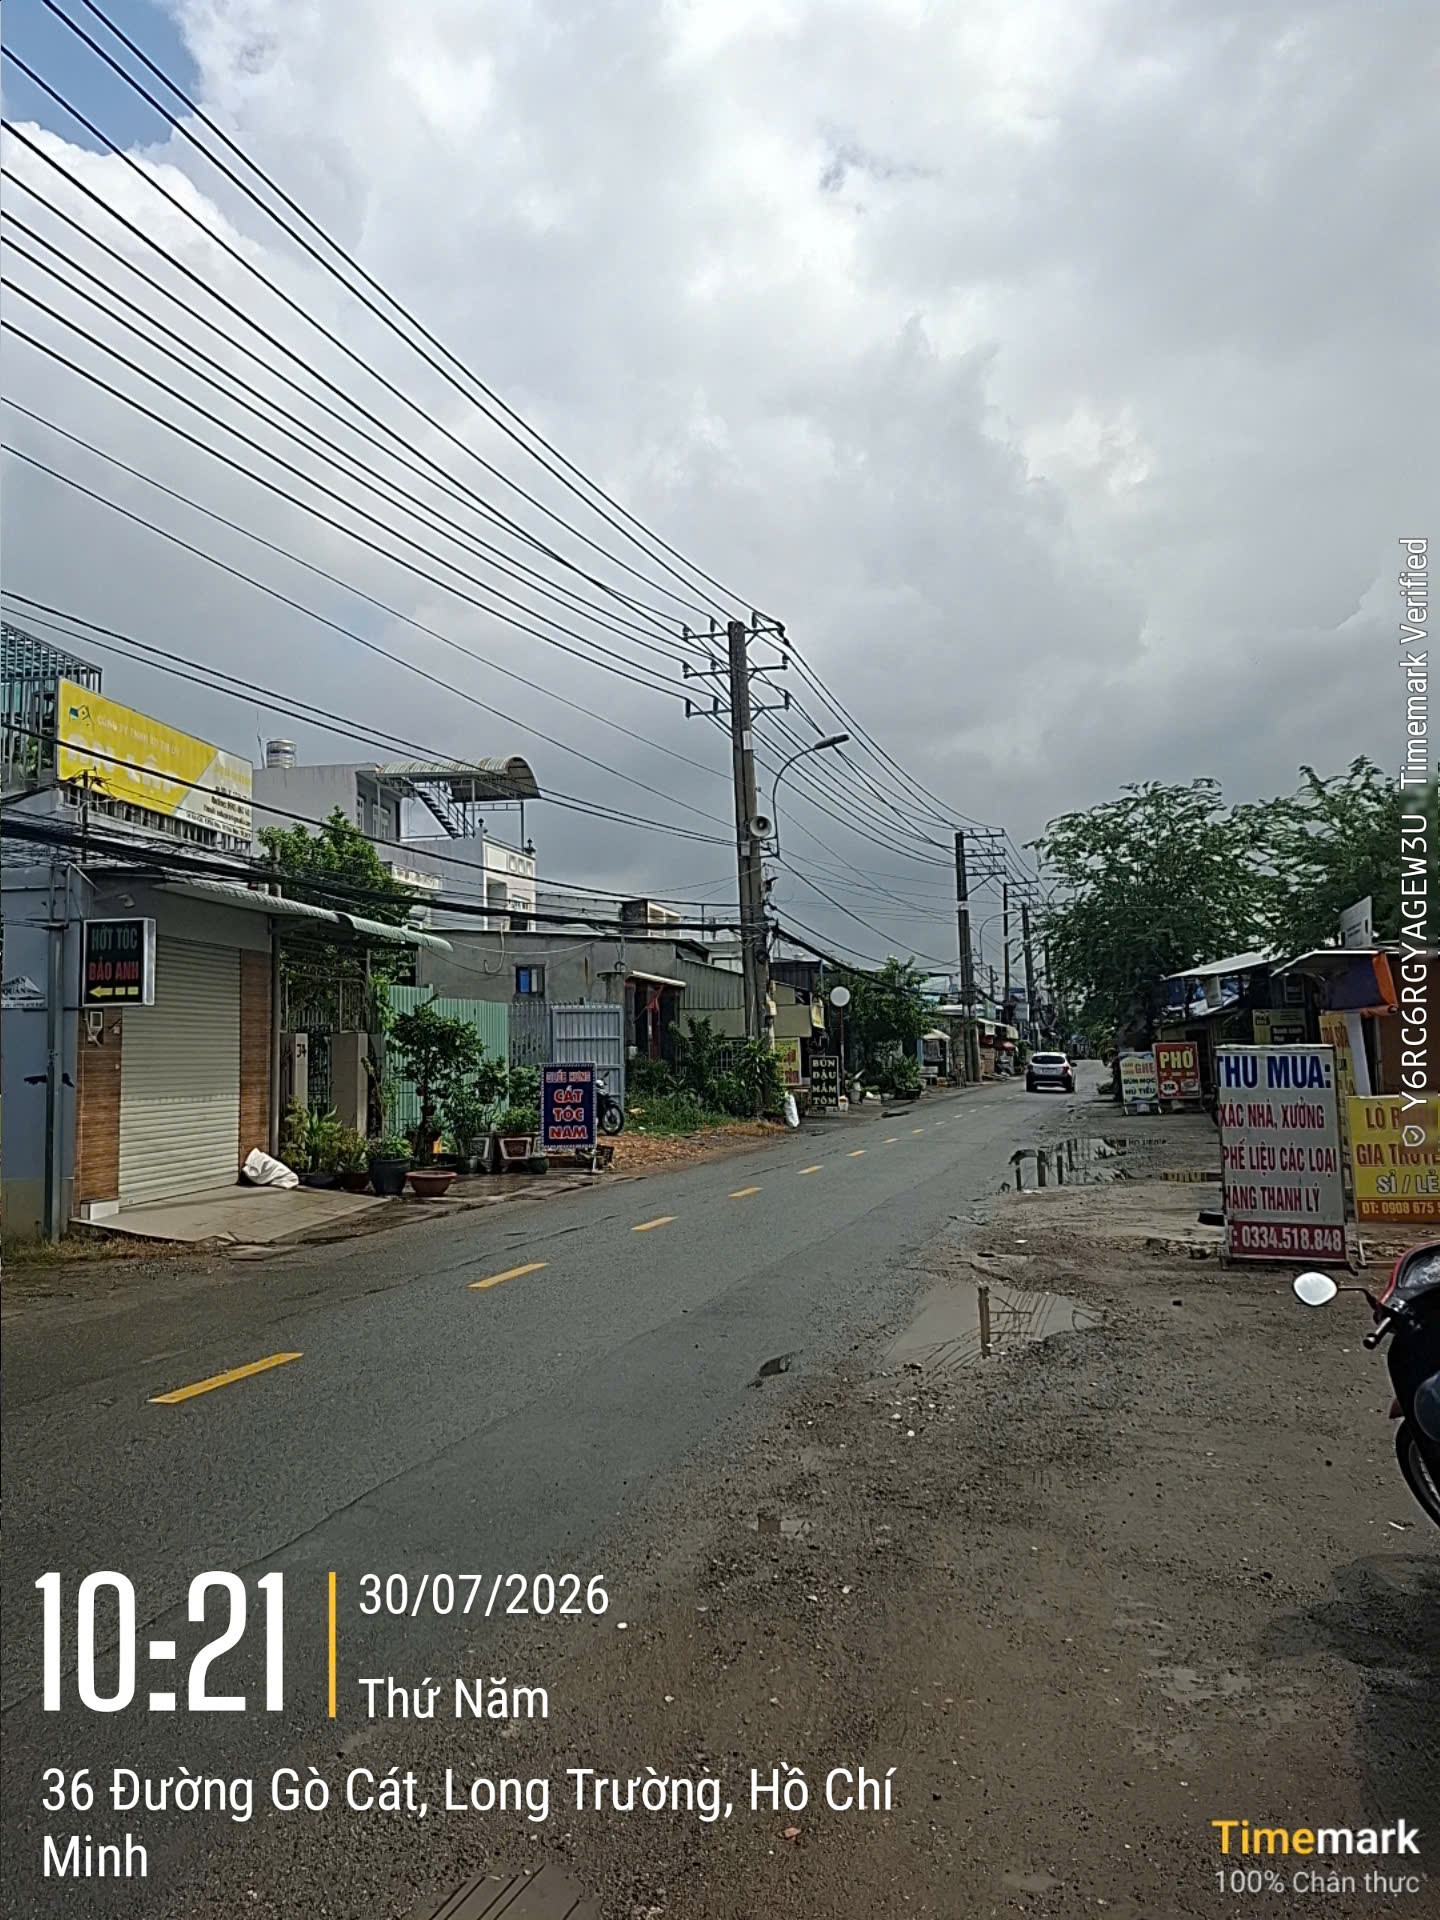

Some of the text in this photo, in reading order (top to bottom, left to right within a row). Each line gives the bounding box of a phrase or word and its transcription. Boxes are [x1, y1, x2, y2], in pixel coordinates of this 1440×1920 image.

[116, 924, 138, 950] TÓC
[115, 960, 139, 981] ANH
[812, 1053, 836, 1068] BÚN
[1160, 1046, 1193, 1069] PHỞ
[1217, 1056, 1258, 1089] THU
[1266, 1056, 1332, 1089] MUA:
[552, 1105, 584, 1122] TÓC
[1219, 1096, 1325, 1130] XÁC NHÀ, XƯỞNG
[1365, 1101, 1386, 1129] LÒ
[548, 1125, 588, 1139] NAM
[1223, 1138, 1338, 1178] PHẾ LIỆU CÁC LOẠI
[1356, 1143, 1385, 1166] GIA
[1377, 1168, 1398, 1194] SỈ
[1225, 1181, 1320, 1212] HÀNG THANH LÝ
[1241, 1225, 1342, 1251] 0334.518.848
